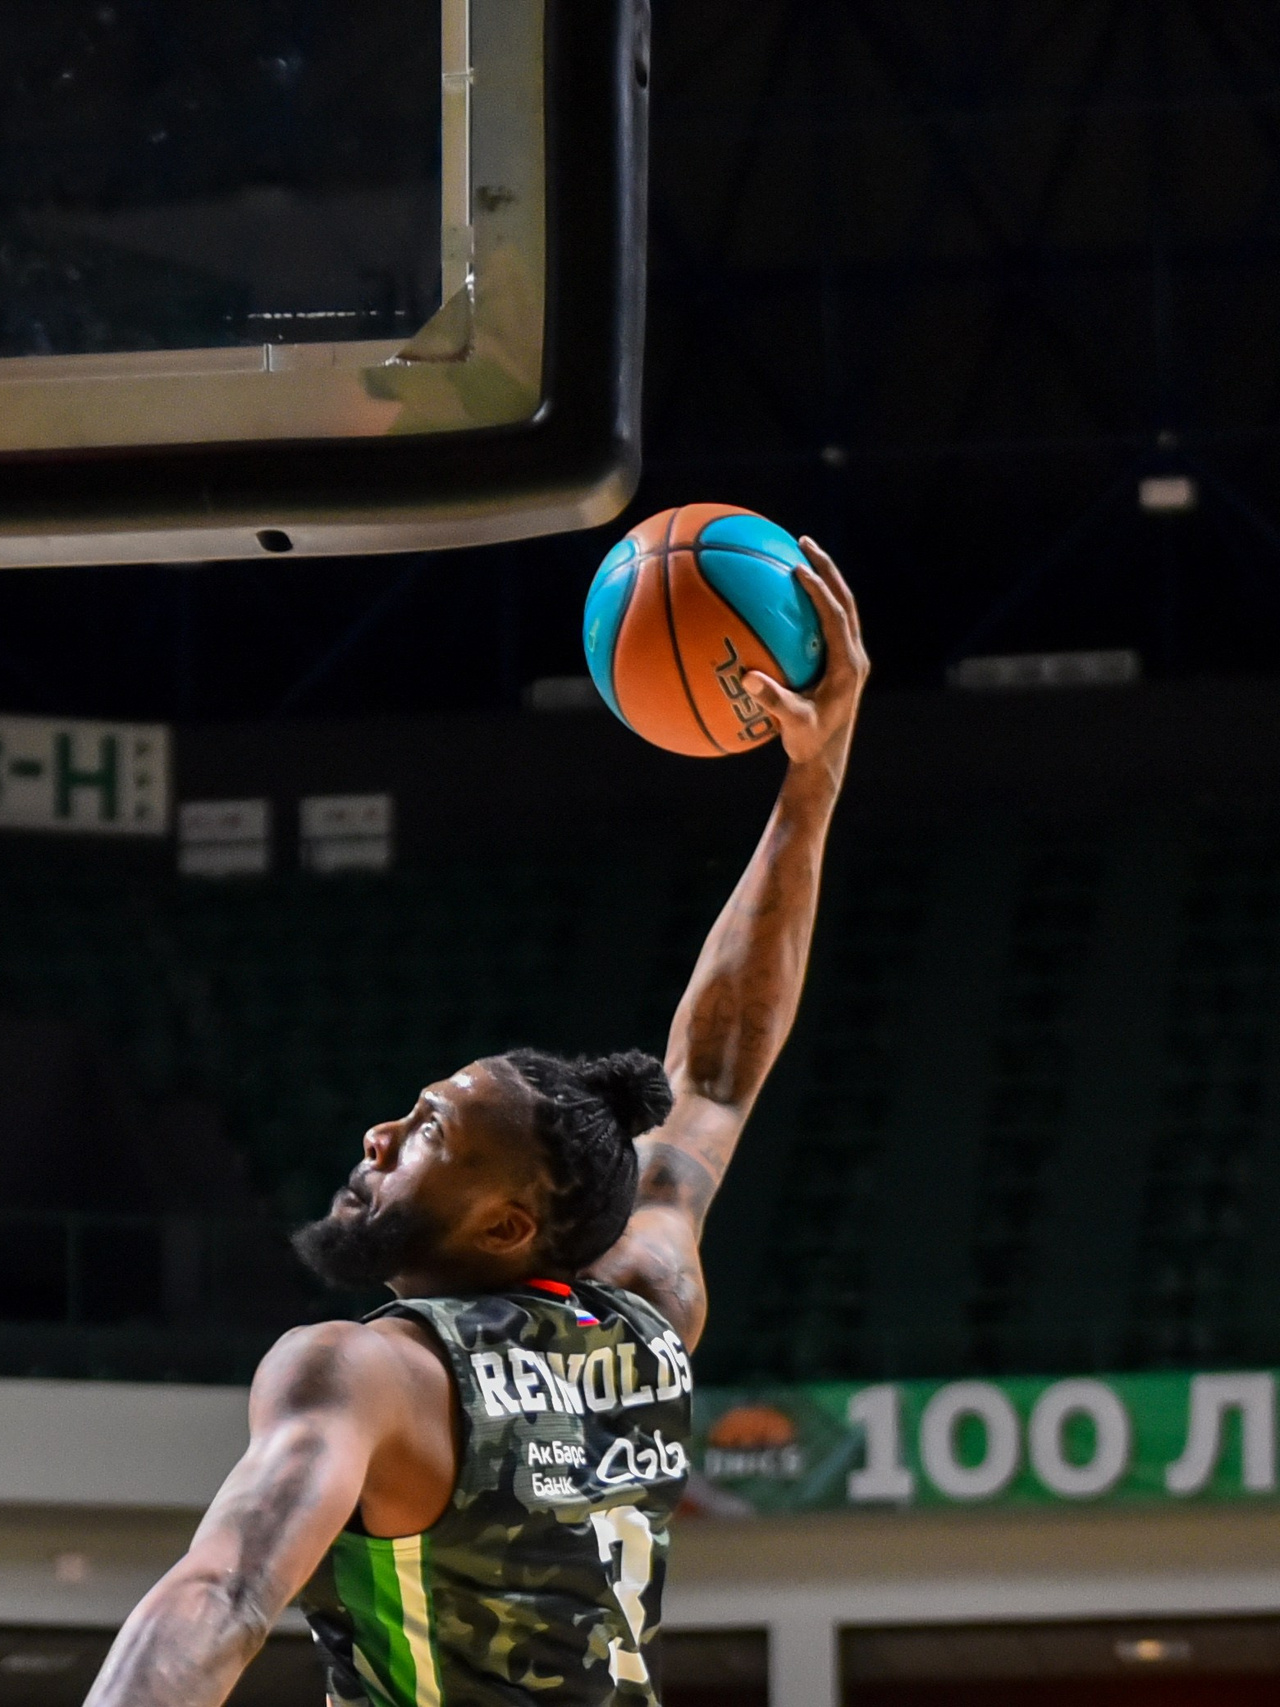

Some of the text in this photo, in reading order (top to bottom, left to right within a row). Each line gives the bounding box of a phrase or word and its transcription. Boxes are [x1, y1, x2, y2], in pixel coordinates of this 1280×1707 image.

[846, 1371, 1276, 1501] 100 Л
[528, 1440, 587, 1469] Ак Барс
[531, 1472, 579, 1497] Банк
